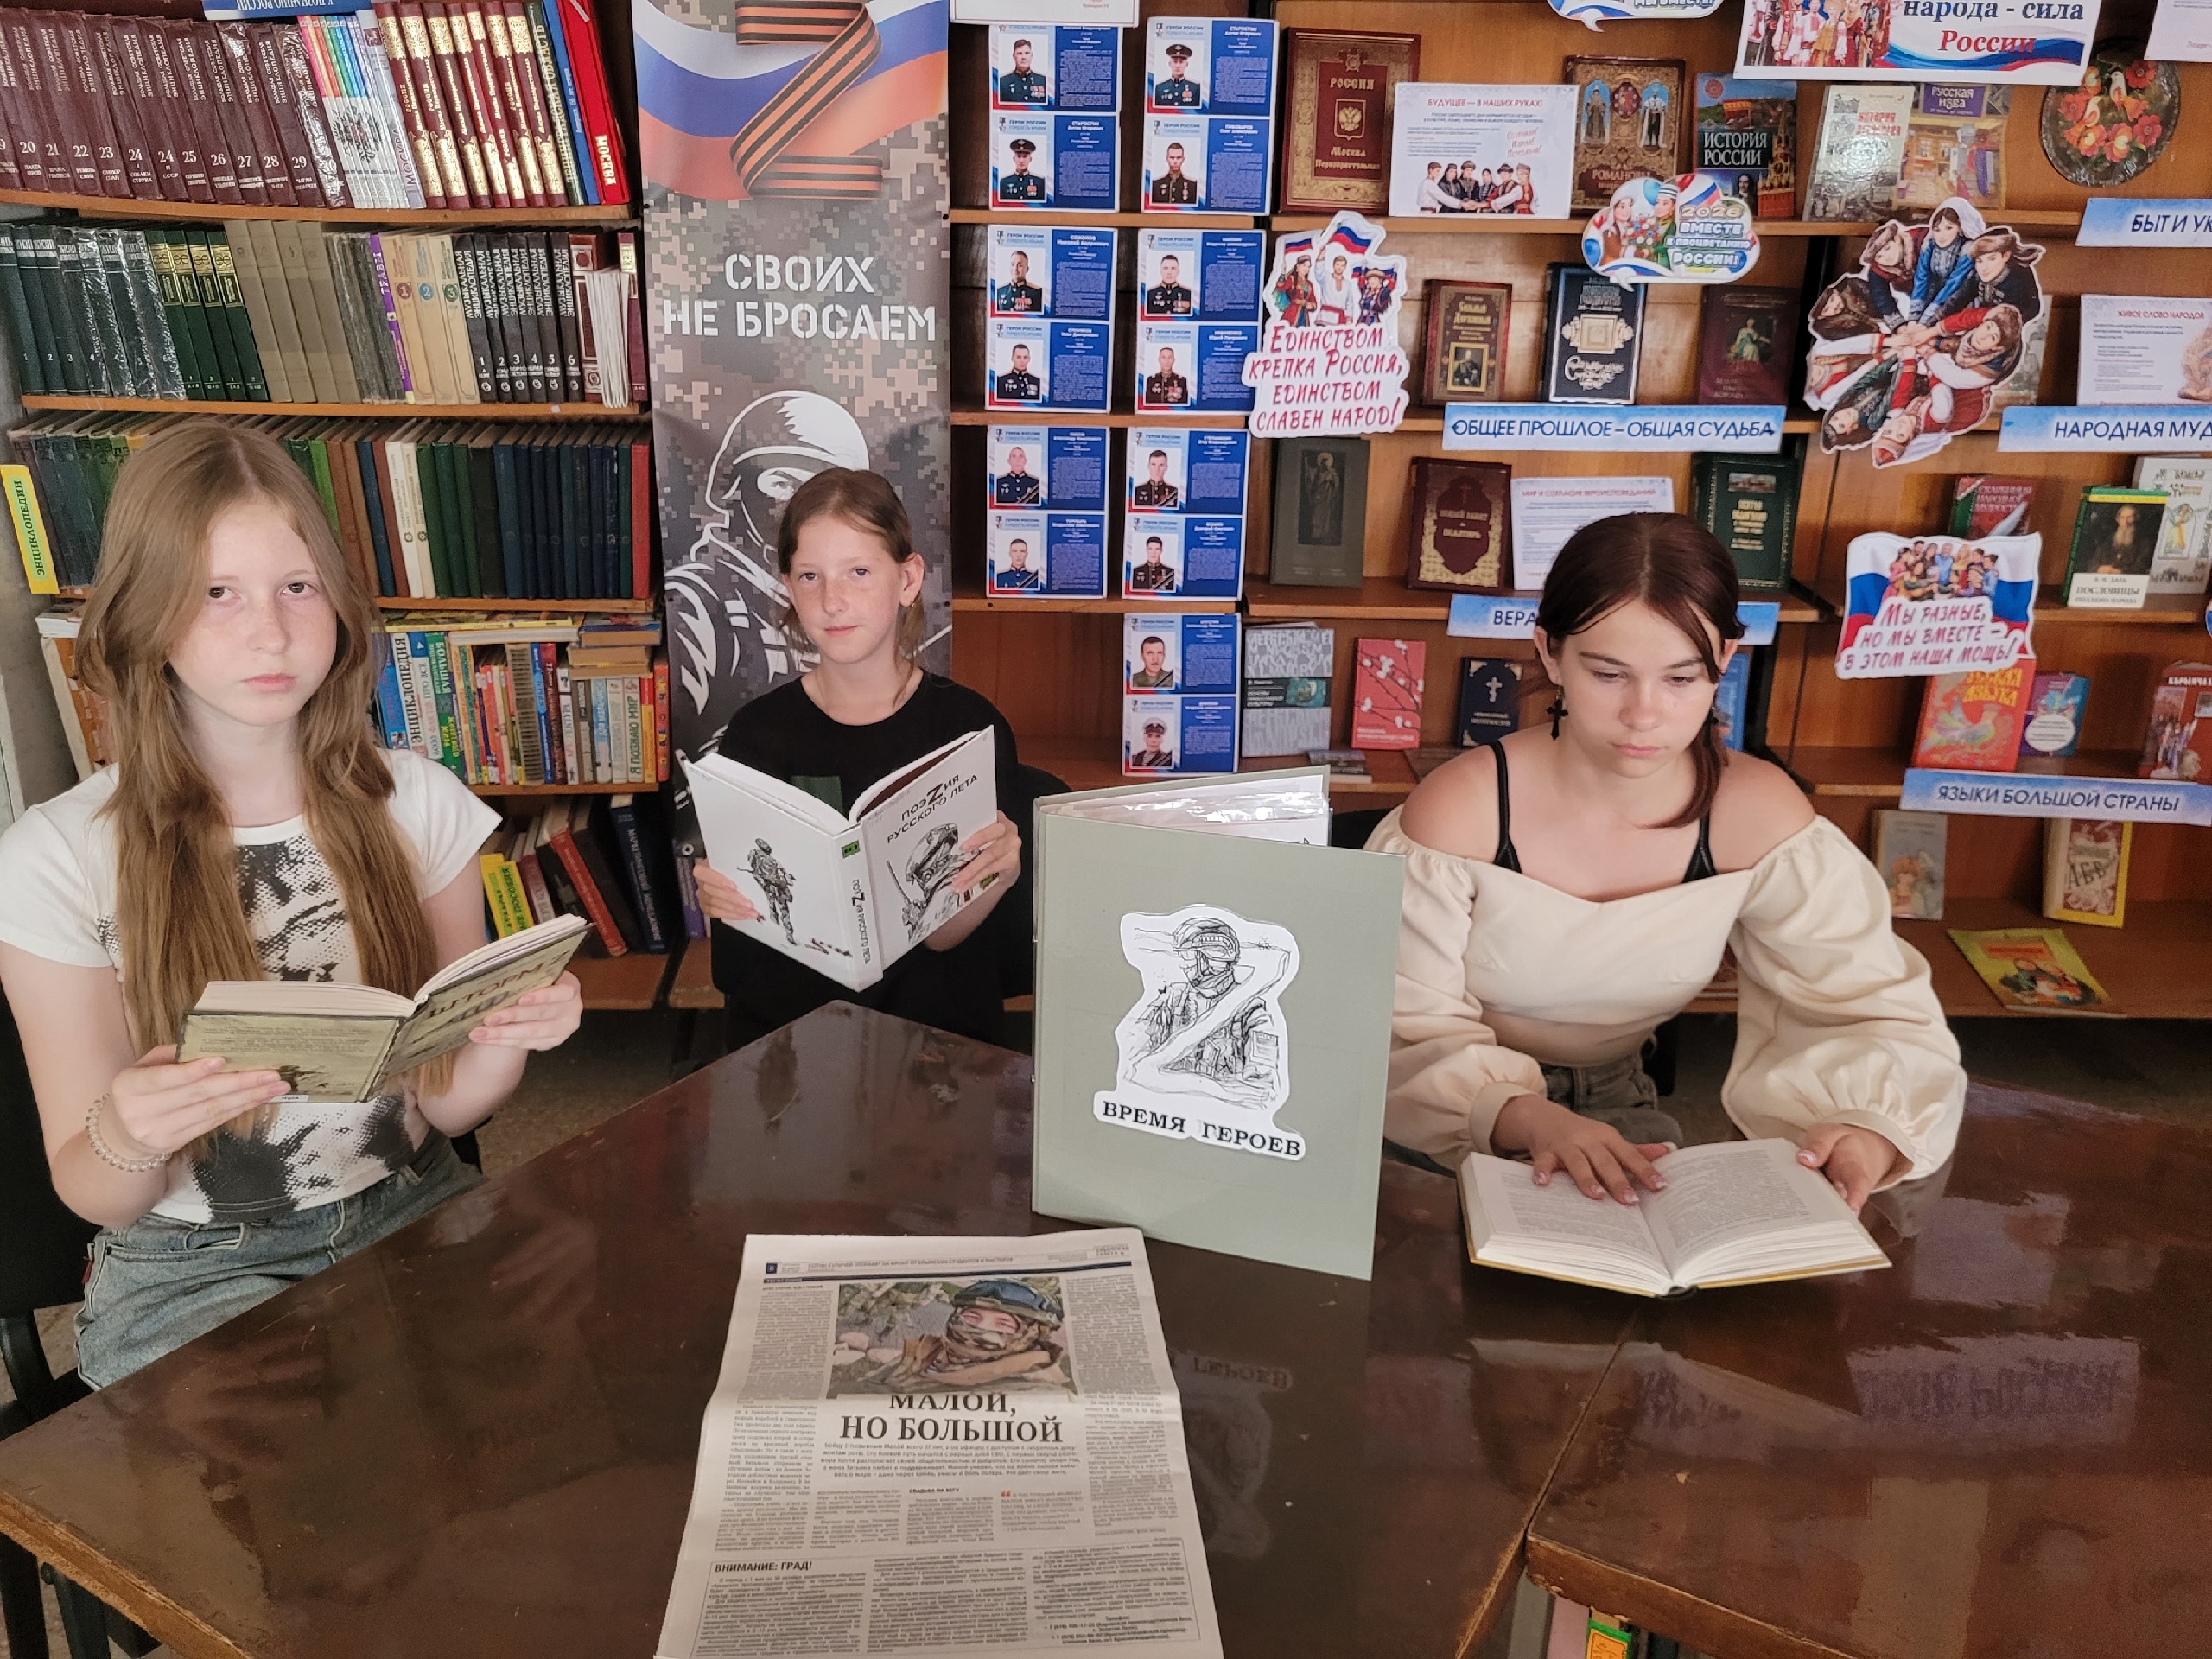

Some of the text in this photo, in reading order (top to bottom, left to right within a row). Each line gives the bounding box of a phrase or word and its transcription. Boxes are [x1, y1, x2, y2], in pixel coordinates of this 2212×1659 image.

[1904, 0, 1999, 22] народа
[2021, 0, 2084, 20] сила
[1938, 30, 2037, 54] России
[264, 41, 288, 105] ЭНЦИКЛОПЕДИЯ
[1329, 78, 1375, 91] РОССИЯ
[1427, 99, 1466, 107] БУДУЩЕЕ
[1483, 99, 1513, 107] НАШИХ
[1513, 99, 1542, 108] РУКАХ!
[20, 141, 36, 154] 20
[1703, 131, 1768, 149] ИСТОРИЯ
[45, 143, 60, 156] 21
[73, 145, 90, 158] 22
[99, 146, 114, 159] 23
[128, 149, 143, 162] 24
[157, 150, 174, 163] 24
[182, 150, 197, 163] 25
[390, 128, 416, 188] МОСКВА
[1331, 146, 1366, 158] Москва
[1703, 149, 1762, 167] РОССИИ
[210, 154, 226, 166] 26
[238, 155, 251, 168] 27
[264, 156, 280, 168] 28
[291, 156, 307, 168] 29
[594, 134, 617, 187] МОСКВА
[1679, 222, 1743, 235] ВМЕСТЕ
[2131, 214, 2170, 233] БЫТ
[2172, 215, 2187, 232] И
[1672, 251, 1740, 266] РОССИИ!
[373, 251, 388, 296] ТРАВЫ
[493, 248, 510, 317] МУЗЫКАЛЬНАЯ
[502, 248, 518, 317] ЭНЦИКЛОПЕДИЯ
[554, 248, 568, 317] МУЗЫКАЛЬНАЯ
[725, 254, 875, 293] СВОИХ
[401, 286, 410, 297] 1
[423, 286, 431, 297] 2
[447, 286, 456, 298] 3
[455, 251, 474, 319] МУЗЫКАЛЬНАЯ
[464, 250, 482, 319] ЭНЦИКЛОПЕДИЯ
[562, 248, 575, 318] ЭНЦИКЛОПЕДИЯ
[663, 299, 936, 341] НЕ БРОСАЕМ
[2117, 309, 2205, 320] ЖИВОЕ СЛОВО НАРОДОВ
[479, 356, 486, 366] 1
[498, 357, 506, 366] 2
[512, 354, 520, 365] 3
[531, 353, 539, 364] 4
[548, 353, 556, 365] 5
[567, 354, 575, 365] 6
[1455, 420, 1516, 438] ОБЩЕЕ
[1519, 421, 1612, 438] ПРОШЛОЕ
[1626, 421, 1695, 440] ОБЩАЯ
[1698, 421, 1775, 440] СУДЬБА
[2055, 421, 2164, 440] НАРОДНАЯ
[13, 480, 46, 576] ЭНЦИКЛОПЕДИИ
[2075, 586, 2140, 596] ПОСЛОВИЦЫ
[1493, 610, 1537, 626] ВЕРА
[1859, 630, 1885, 649] НО
[1890, 628, 1919, 646] МЫ
[1924, 626, 1984, 644] ВМЕСТЕ
[435, 641, 451, 695] БОЛЬШАЯ
[1843, 655, 1853, 671] В
[1859, 651, 1904, 669] ЭТОМ
[1909, 647, 1952, 665] НАША
[393, 637, 423, 744] ЭНЦИКЛОПЕДИЯ
[628, 721, 641, 762] ПОЗНАЮ
[1937, 785, 2180, 812] ЯЗЫКИ БОЛЬШОЙ СТРАНЫ
[886, 773, 979, 844] РУССКОГО ЛЕТА
[429, 963, 546, 1019] ШТОРМ
[1102, 1100, 1302, 1158] ВРЕМЯ ГЕРОЕВ
[887, 1393, 1018, 1419] МАЛОЙ,
[840, 1414, 1064, 1444] НО БОЛЬШОЙ
[714, 1560, 813, 1573] ВНИМАНИЕ: ГРАД!
